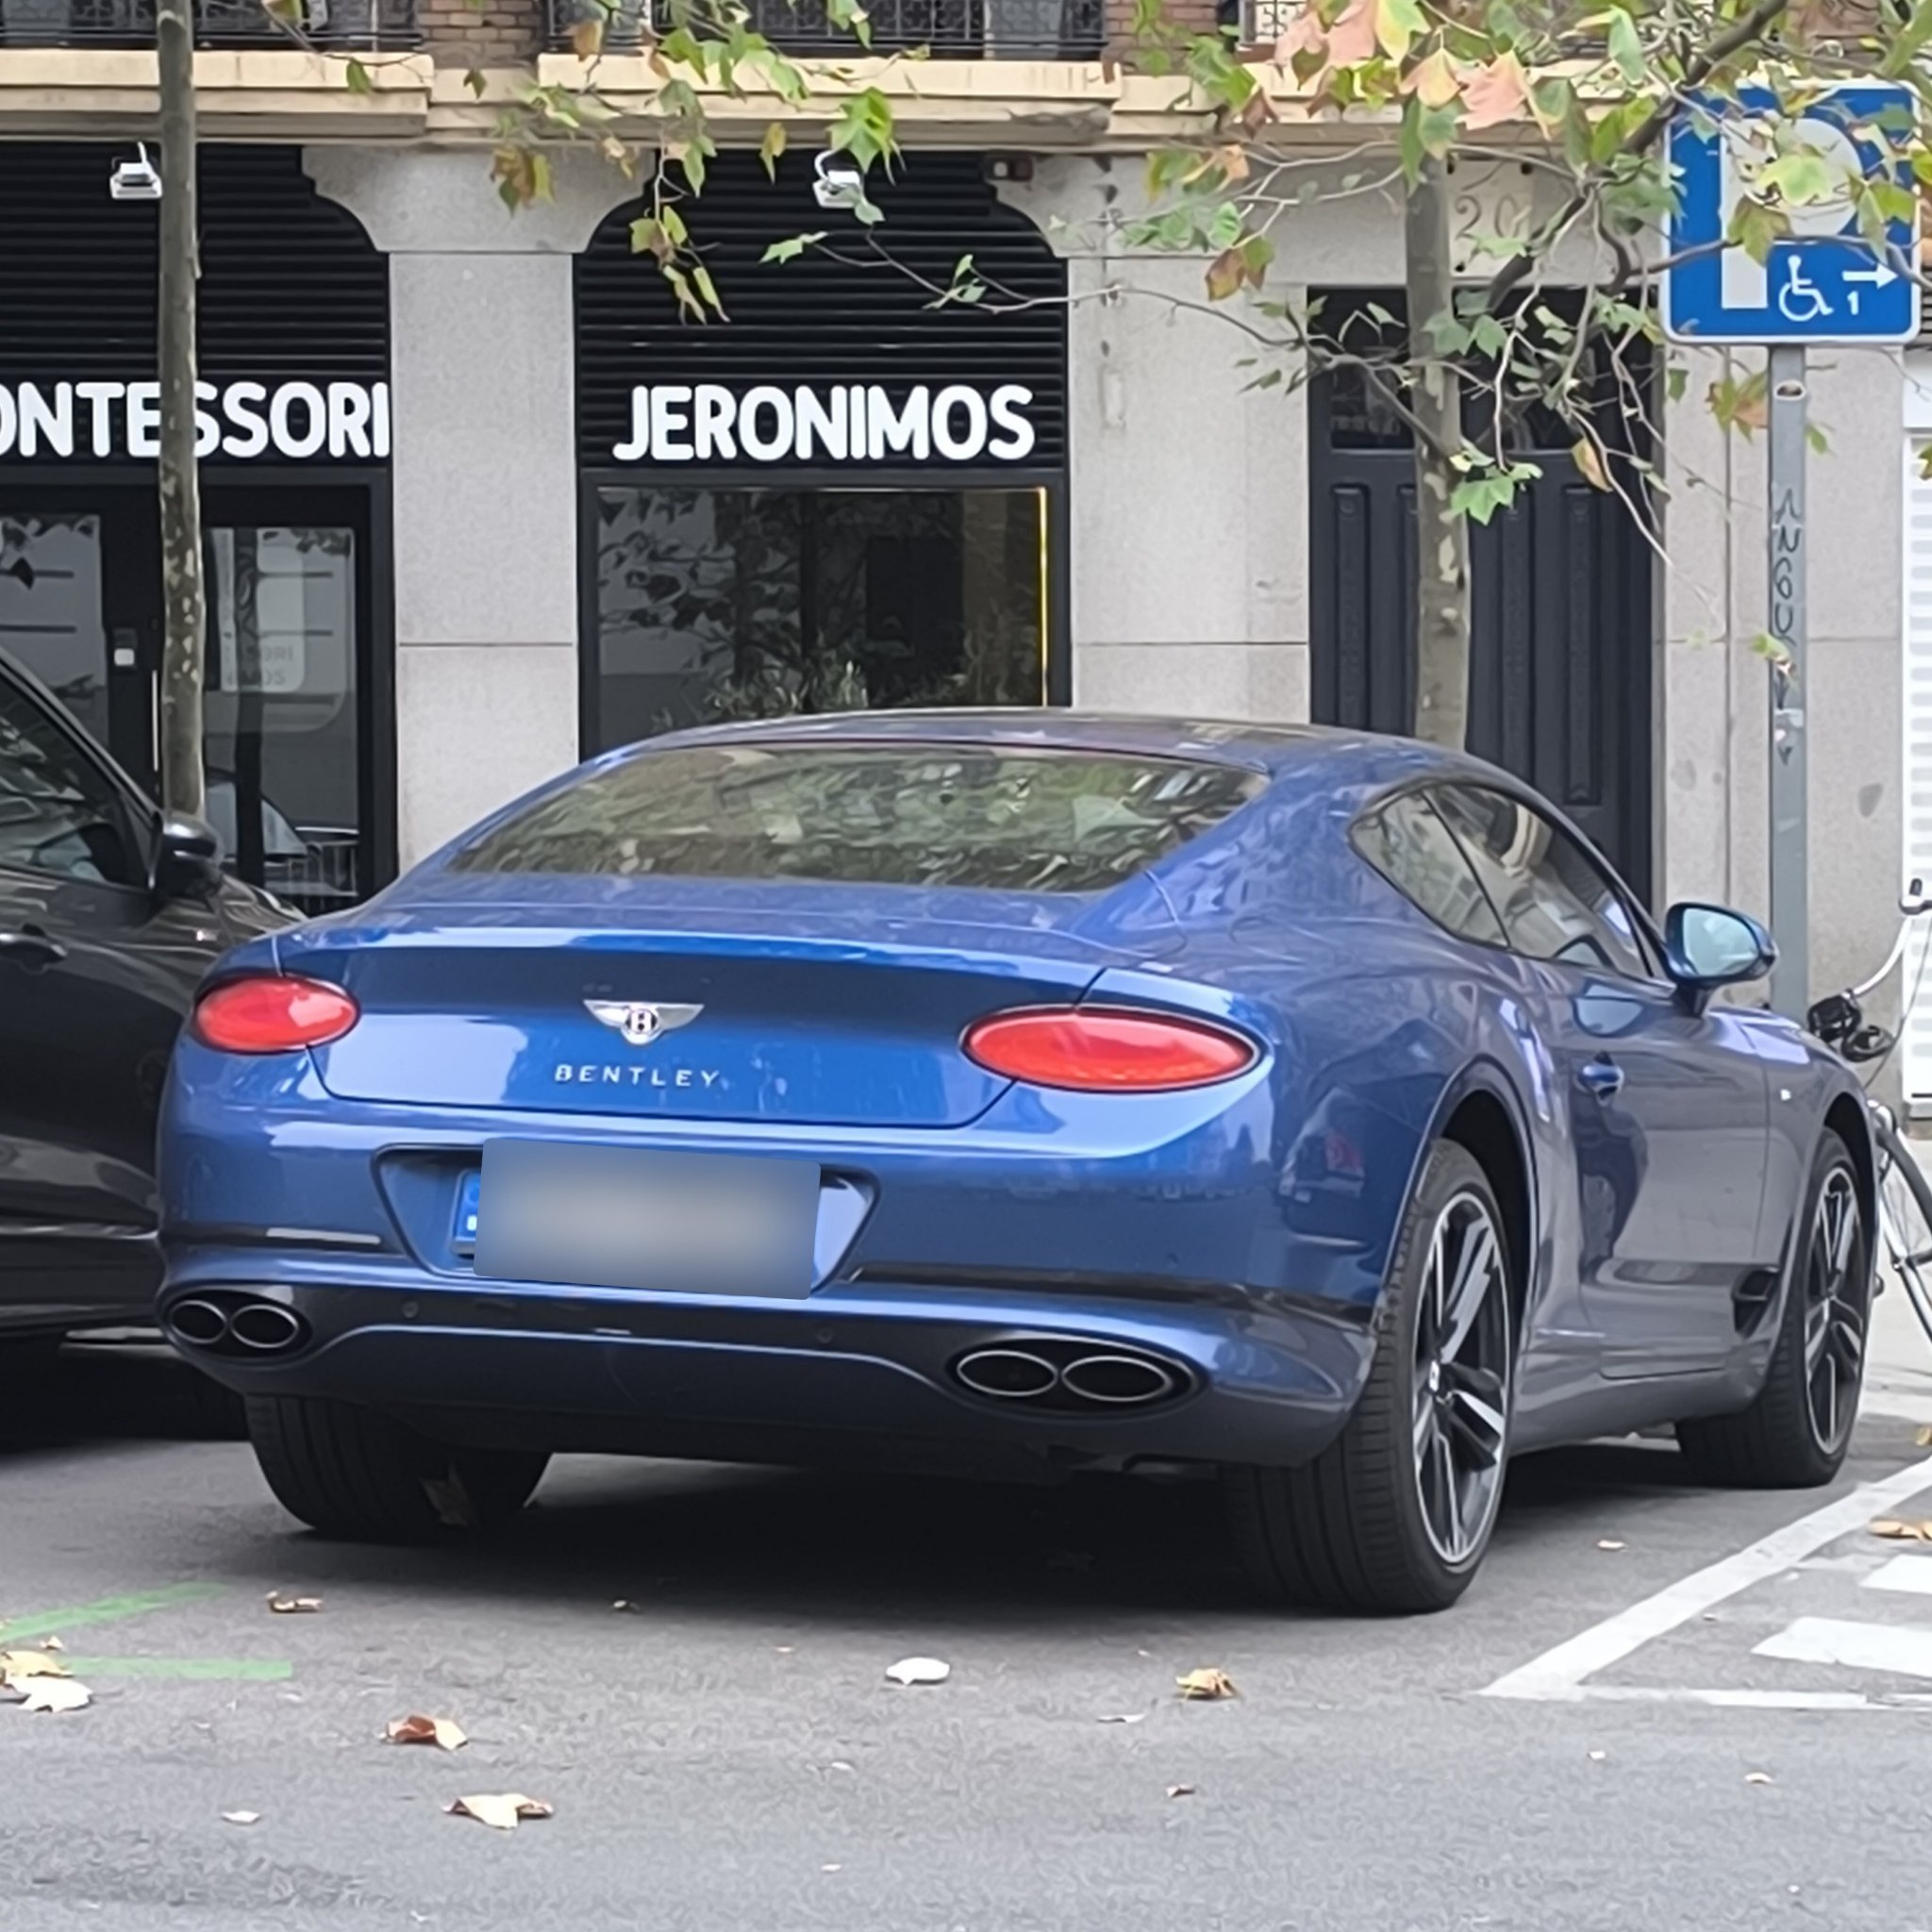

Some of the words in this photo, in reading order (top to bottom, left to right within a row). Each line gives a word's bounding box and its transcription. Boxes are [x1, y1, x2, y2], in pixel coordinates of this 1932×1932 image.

[1846, 291, 1859, 316] 1
[0, 382, 391, 458] NTESSORI
[612, 384, 1036, 461] JERONIMOS
[554, 1063, 720, 1089] BENTLEY
